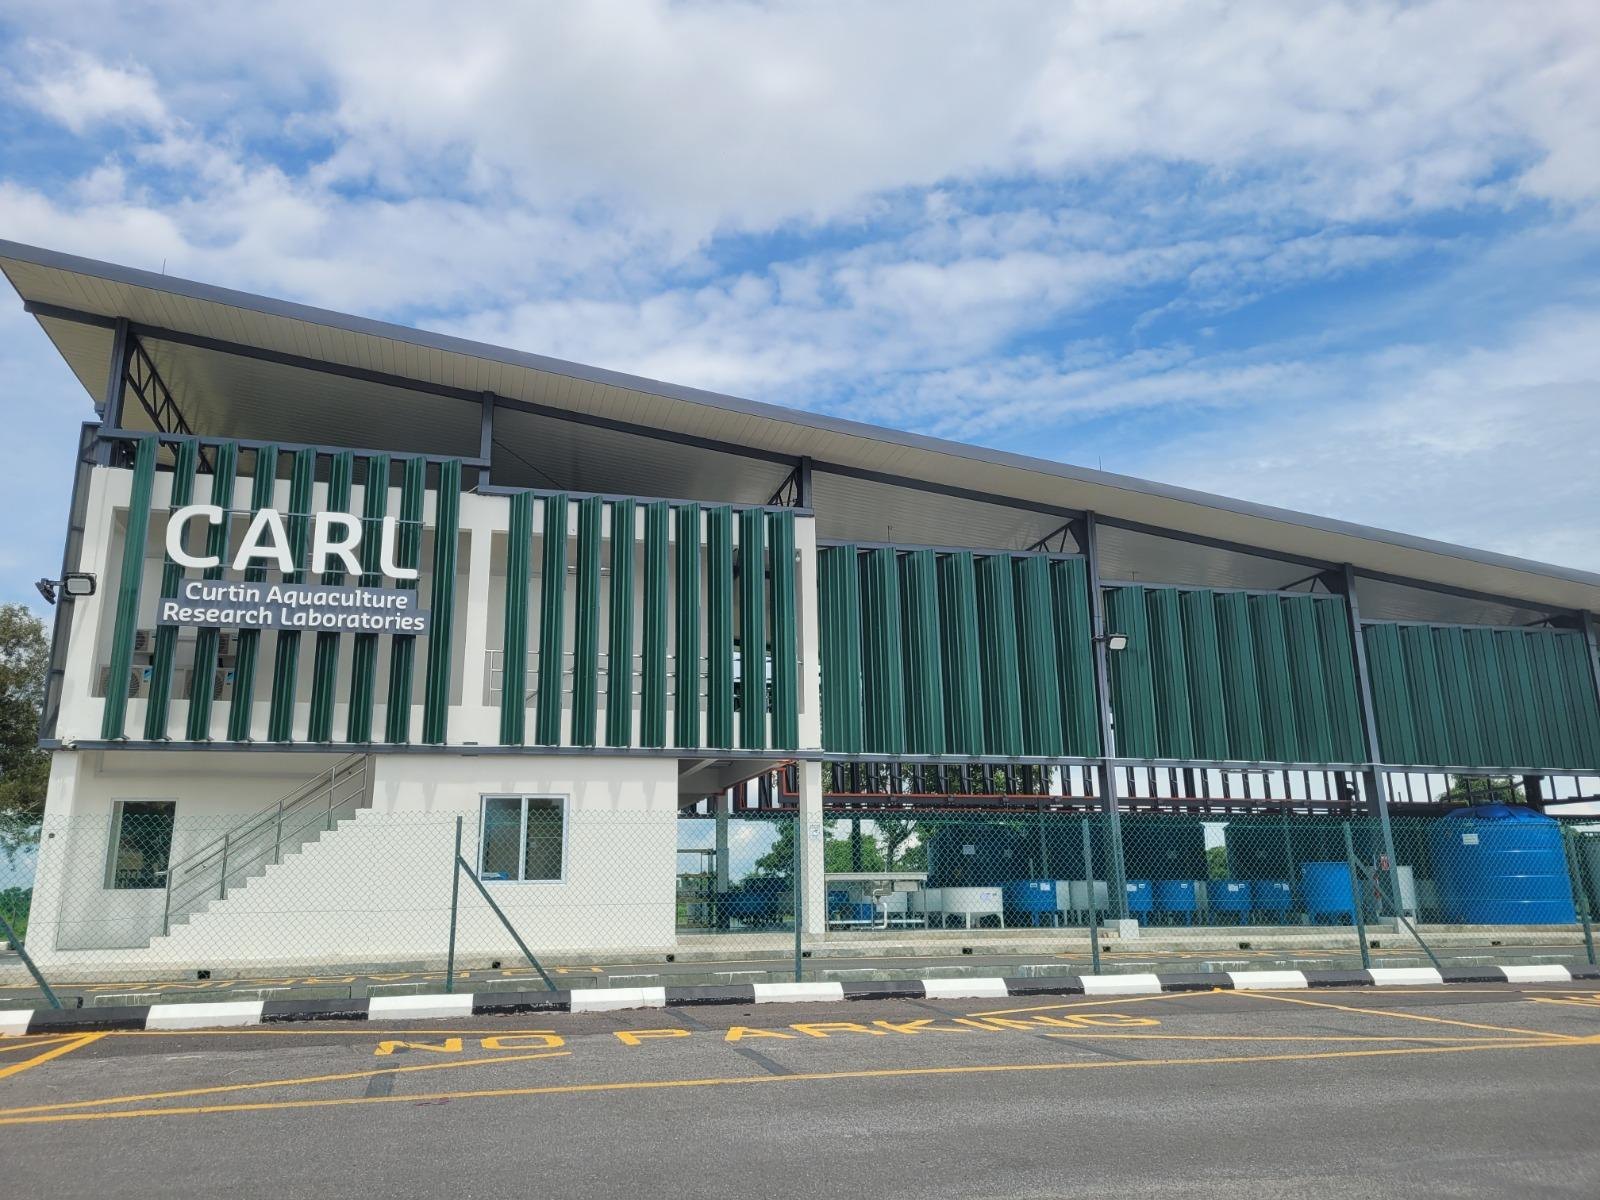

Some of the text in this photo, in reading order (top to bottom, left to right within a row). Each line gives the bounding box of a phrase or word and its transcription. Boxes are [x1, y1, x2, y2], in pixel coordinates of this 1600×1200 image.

[165, 504, 418, 579] CARL
[185, 582, 408, 609] Curtin Aquaculture
[162, 602, 425, 630] Research Laboratories
[374, 1014, 1162, 1056] NO PARKING
